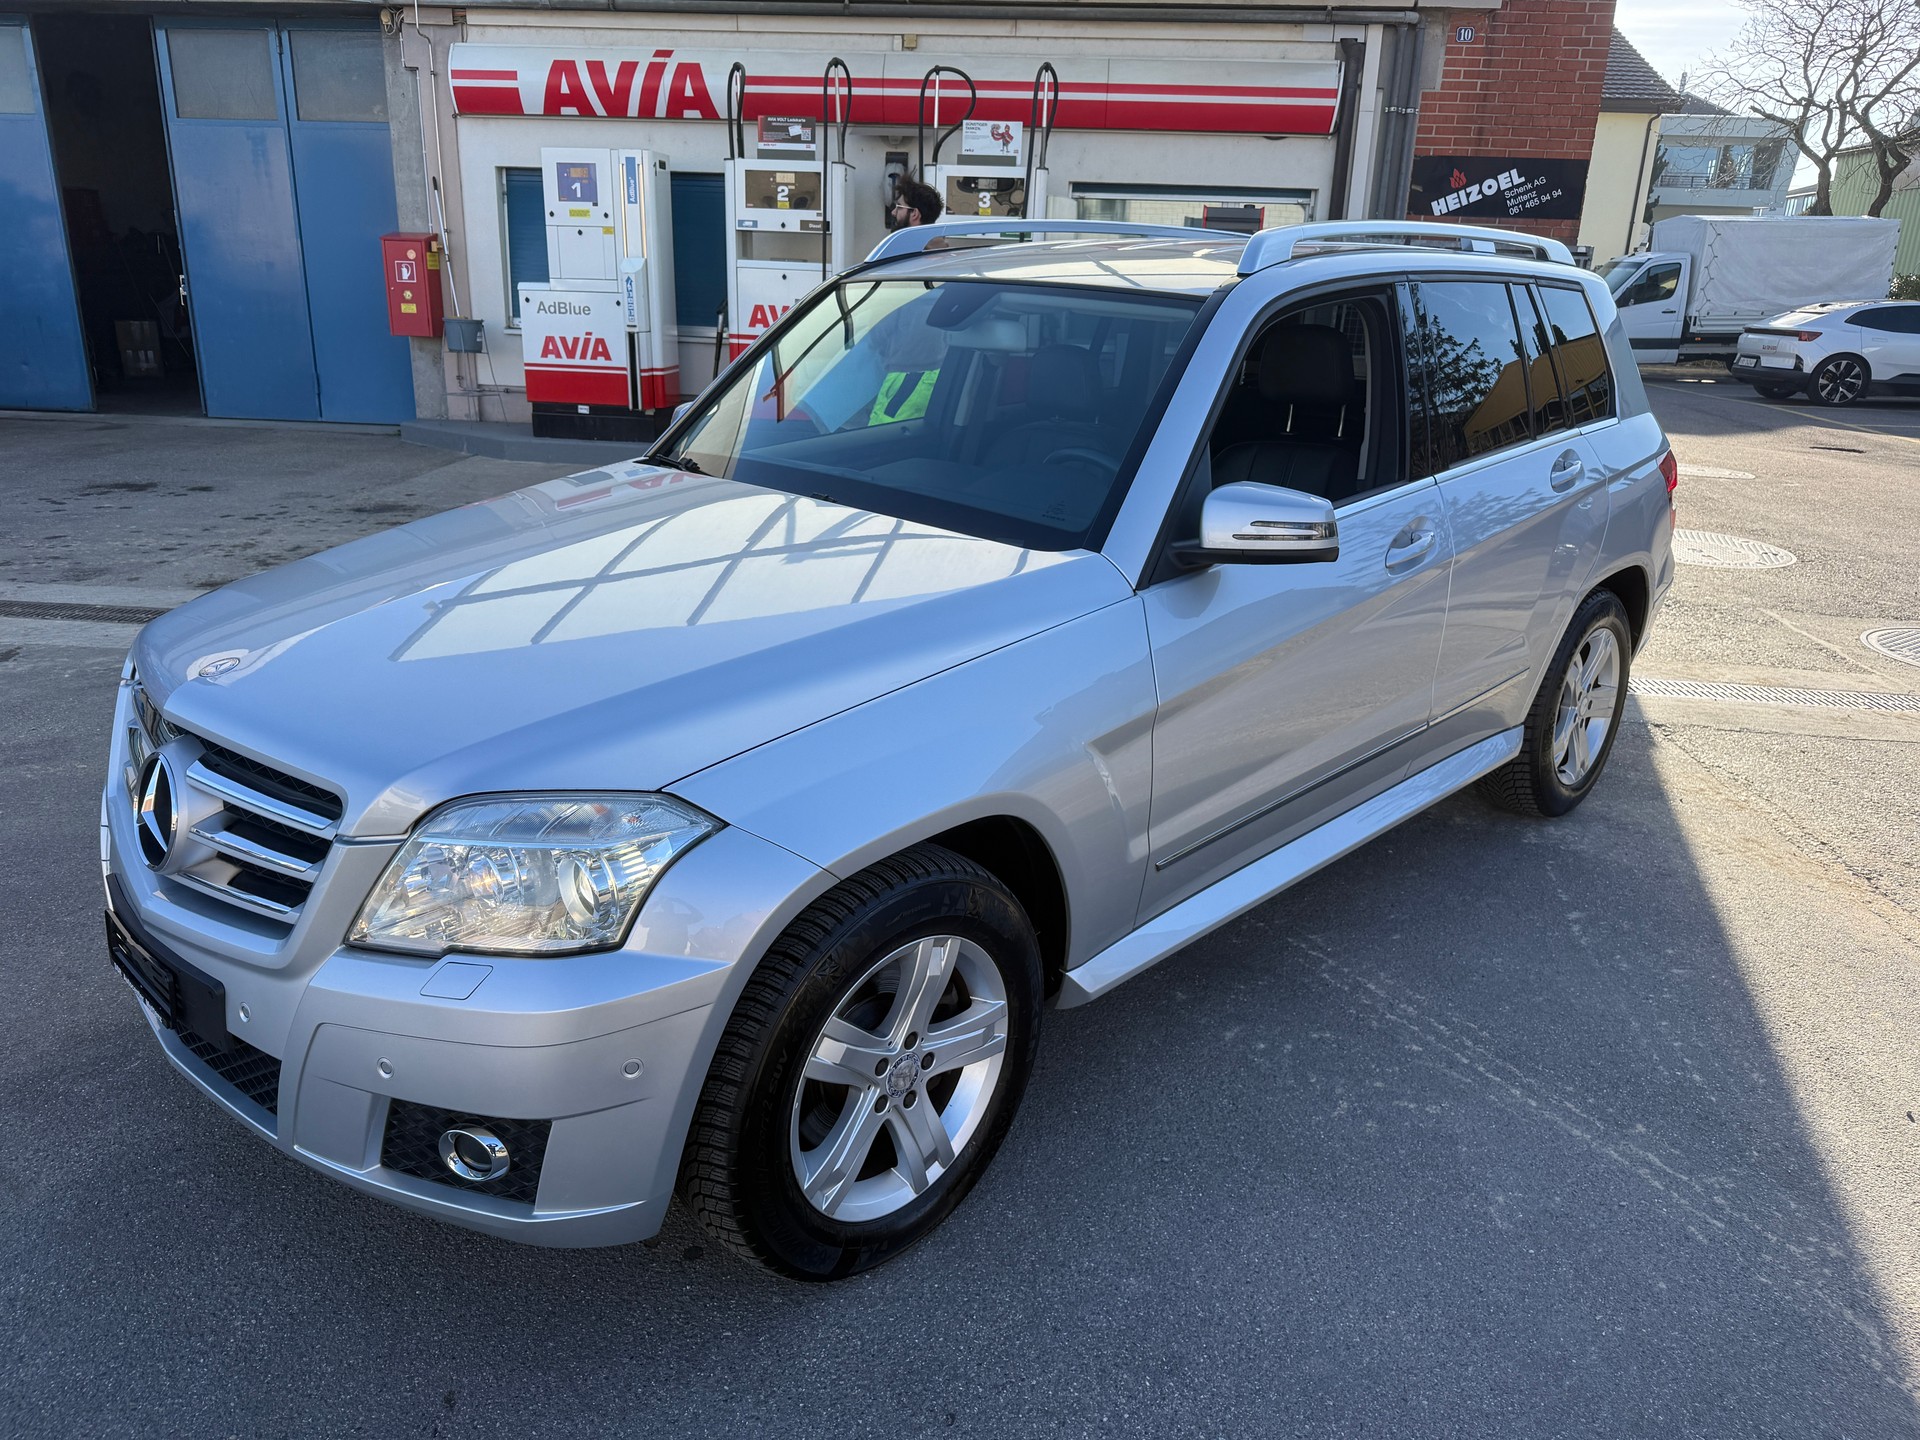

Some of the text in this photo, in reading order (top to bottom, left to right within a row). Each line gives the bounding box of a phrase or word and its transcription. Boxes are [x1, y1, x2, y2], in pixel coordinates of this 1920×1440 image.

[1460, 28, 1472, 41] 10
[571, 182, 581, 198] 1
[777, 185, 789, 202] 2
[1430, 168, 1526, 216] HEIZOEL
[1504, 176, 1547, 199] Schenk AG
[978, 191, 991, 208] 3
[1506, 190, 1538, 207] Muttenz
[1509, 188, 1562, 216] 061 465 94 94
[536, 300, 592, 316] AdBlue
[768, 1047, 789, 1095] SUV
